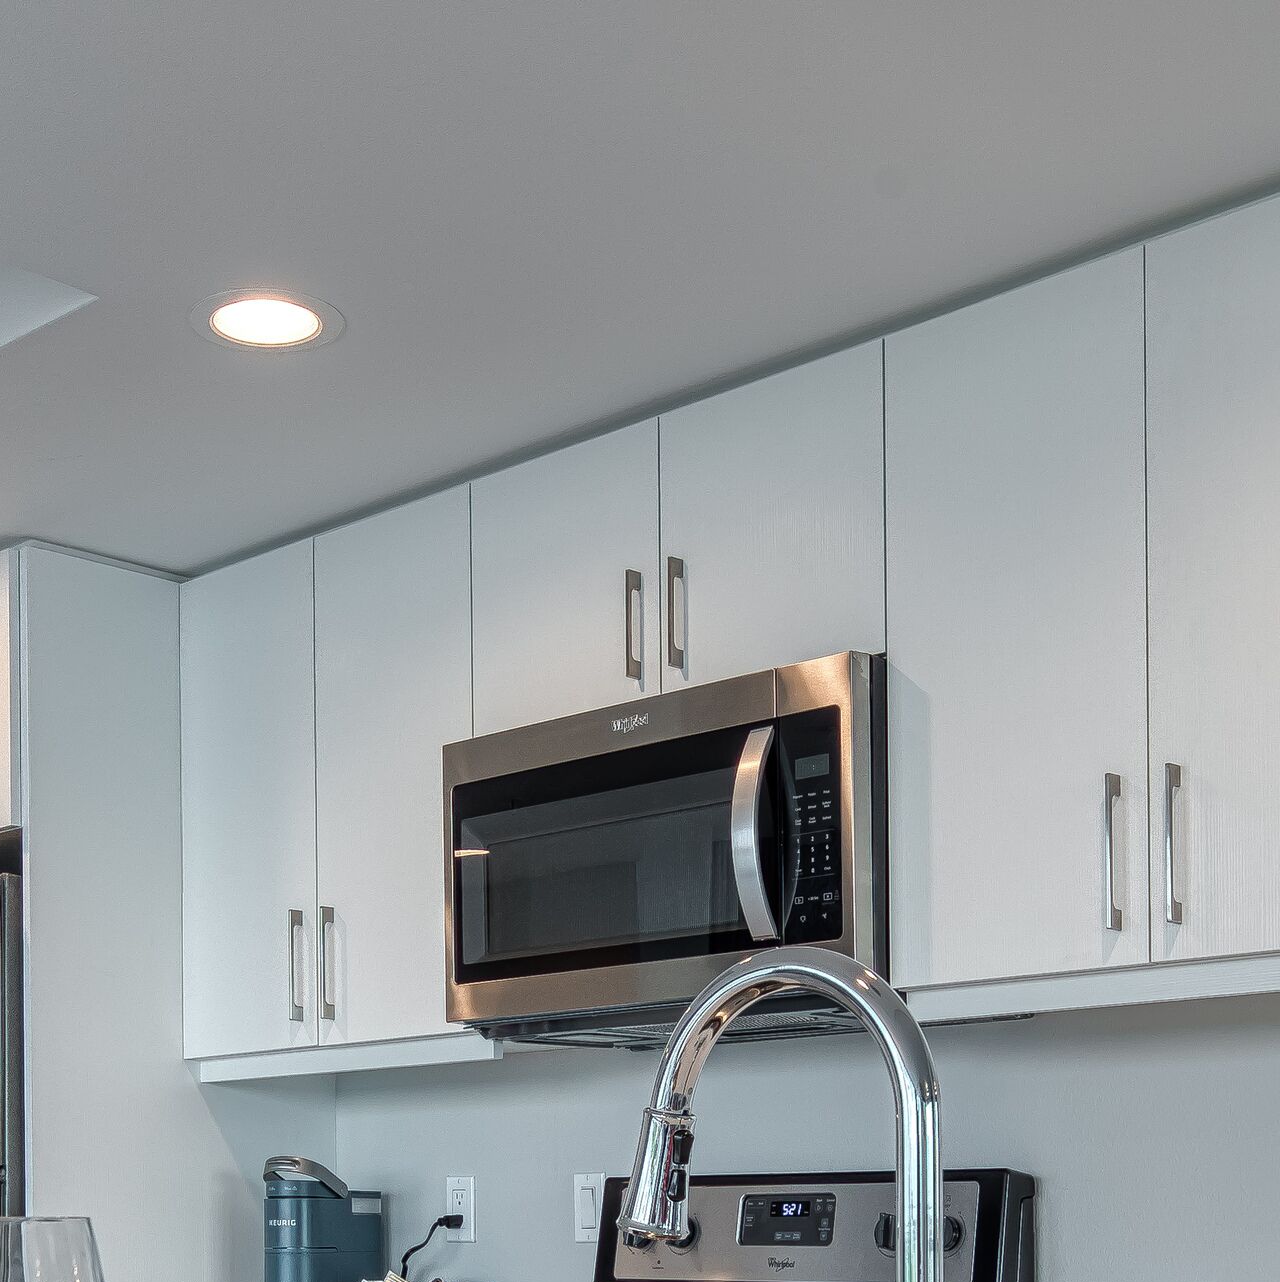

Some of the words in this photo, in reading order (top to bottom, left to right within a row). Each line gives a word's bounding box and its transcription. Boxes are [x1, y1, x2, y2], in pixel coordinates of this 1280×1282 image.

[782, 1203, 802, 1216] 5:21
[268, 1219, 297, 1227] KEURIG
[768, 1257, 796, 1272] Whirlpool
